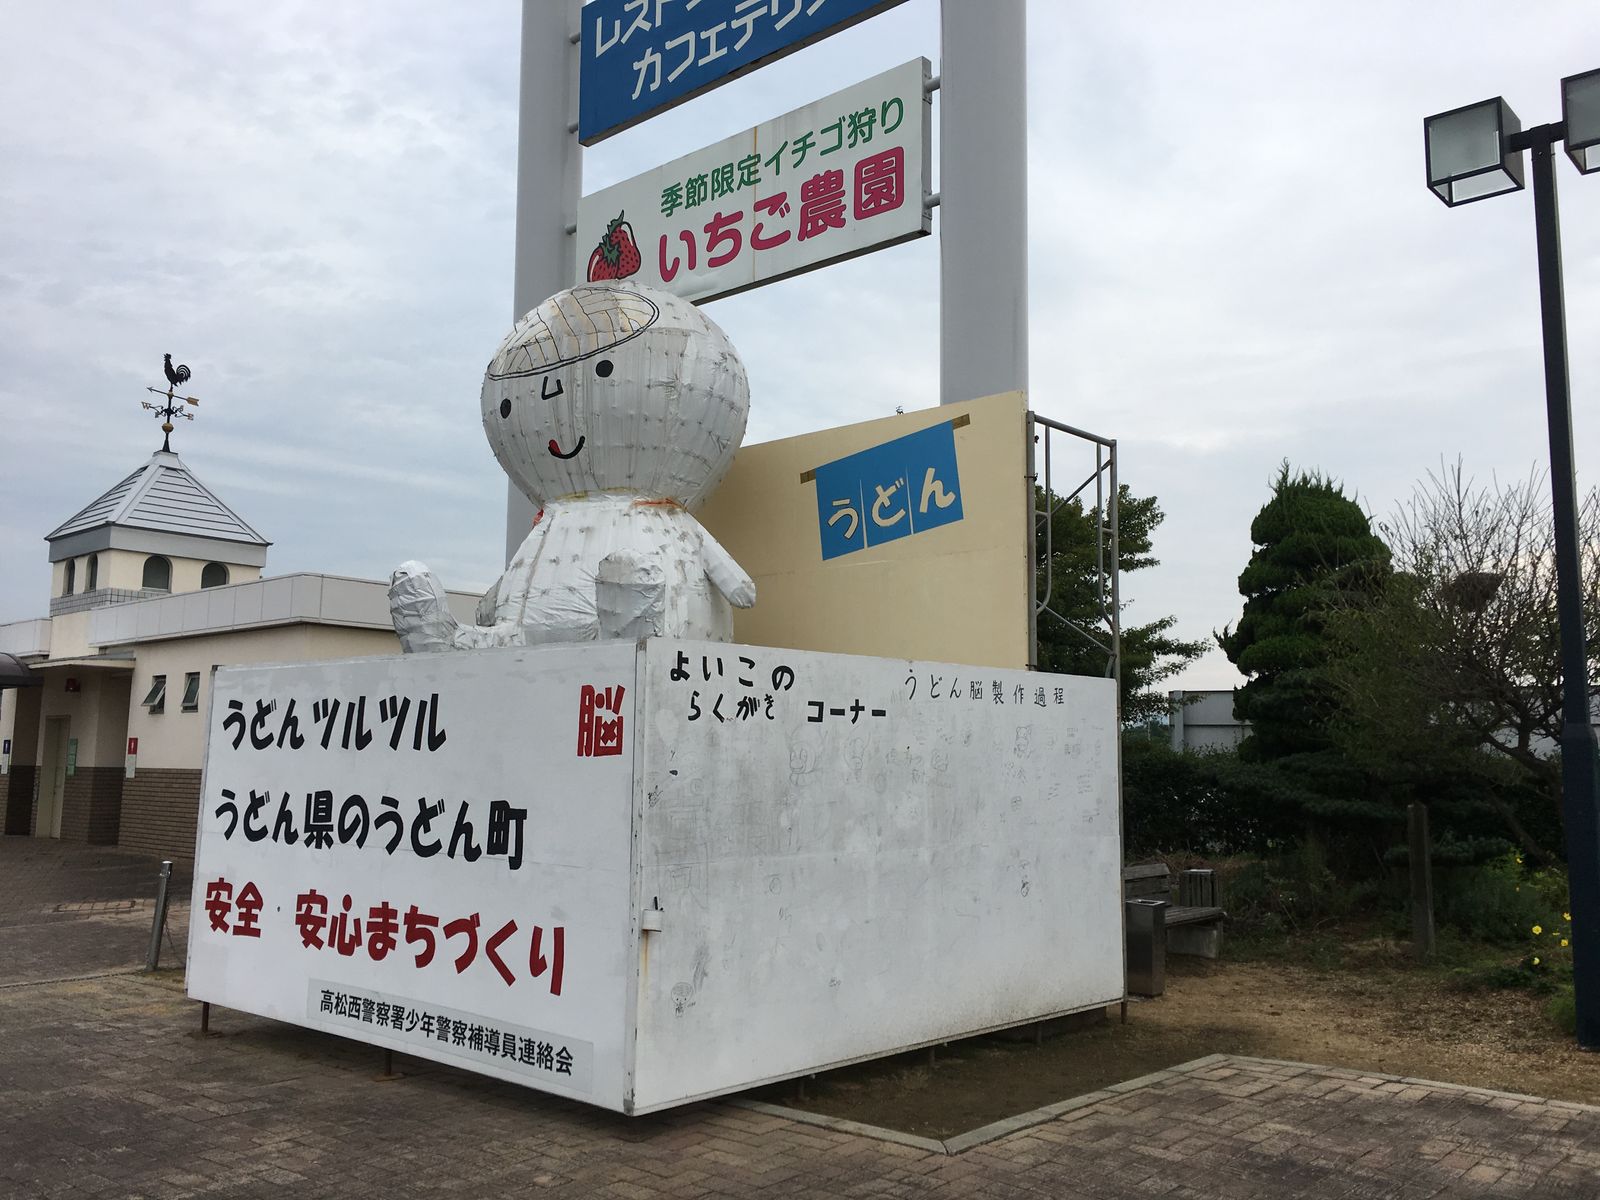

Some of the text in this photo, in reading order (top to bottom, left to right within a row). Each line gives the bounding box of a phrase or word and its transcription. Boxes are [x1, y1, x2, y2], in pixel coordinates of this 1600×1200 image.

[660, 97, 904, 217] 季節限定イチゴ狩り
[658, 146, 905, 283] いちご農園
[828, 467, 956, 539] うどん
[670, 651, 795, 691] よいこの
[688, 690, 887, 724] らくがき コーナー
[905, 669, 1065, 707] うどん脳製作過程
[222, 693, 447, 752] うどんツルツル
[577, 684, 626, 758] 脳
[215, 789, 527, 870] うどん県のうどん町
[320, 989, 574, 1077] 高松西警察署少年警察補導員連絡会
